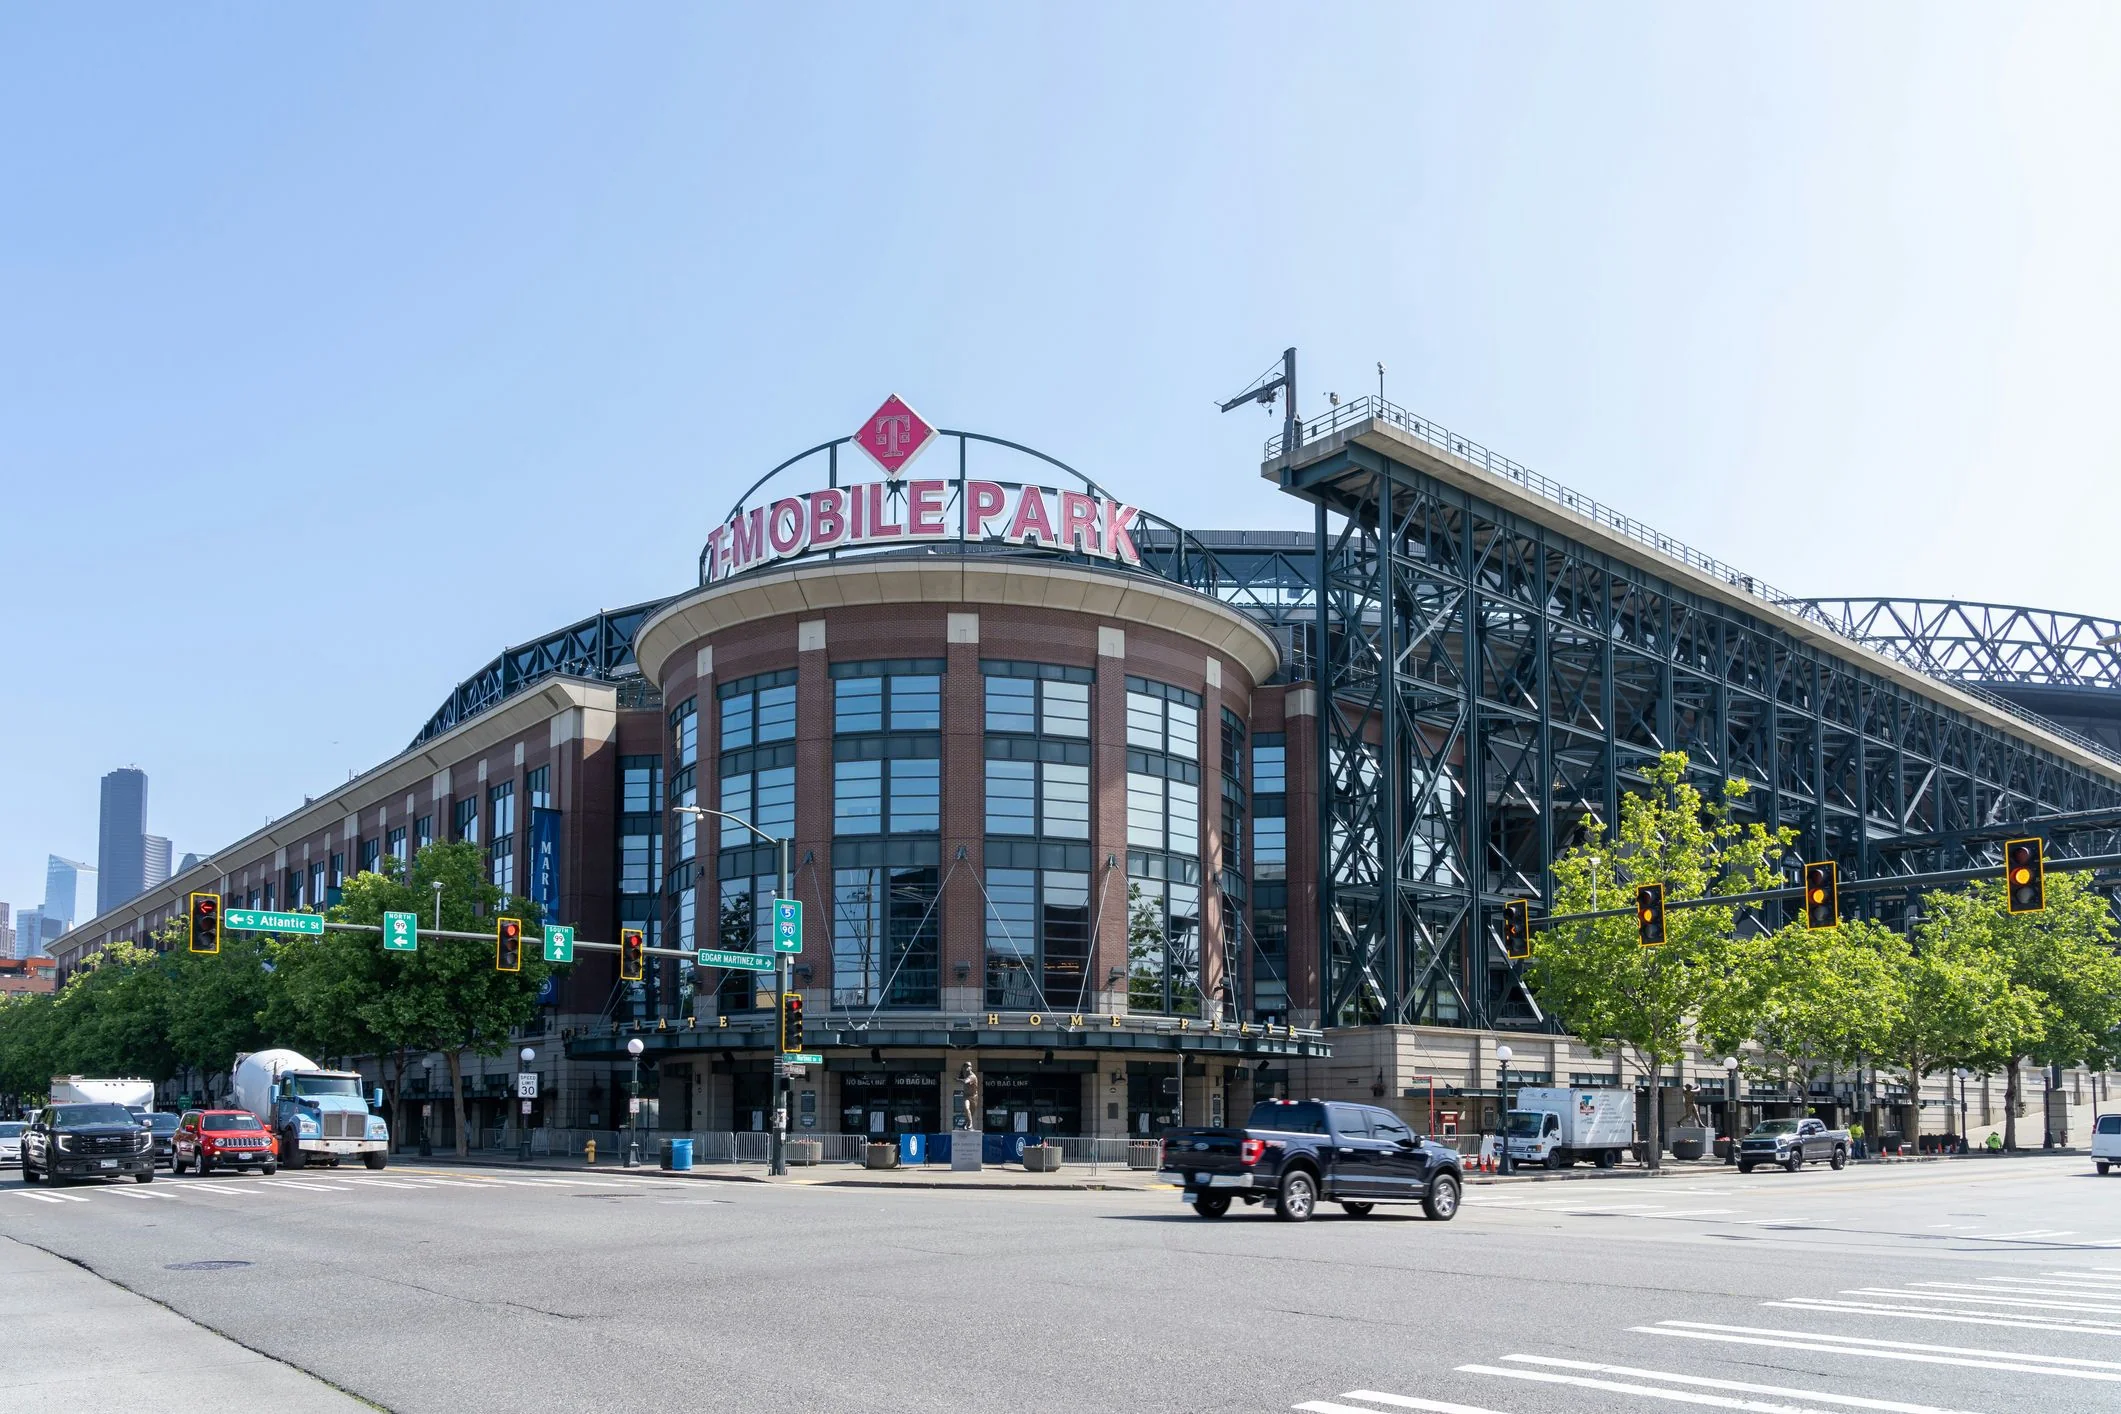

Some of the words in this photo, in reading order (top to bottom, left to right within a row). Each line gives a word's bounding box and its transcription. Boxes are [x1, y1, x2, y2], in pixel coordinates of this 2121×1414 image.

[707, 478, 948, 582] T-MOBILE
[963, 479, 1142, 568] PARK
[785, 909, 791, 917] 5
[246, 914, 255, 925] S
[260, 915, 306, 929] Atlantic
[310, 921, 319, 929] St
[396, 922, 405, 930] 99
[782, 926, 794, 935] 90
[701, 952, 722, 962] EDGAR
[723, 954, 754, 966] MARTINEZ
[755, 958, 763, 966] DR
[611, 1015, 728, 1032] PLATE
[987, 1013, 1121, 1027] HOME
[1180, 1017, 1296, 1036] PLATE
[521, 1086, 535, 1095] 30
